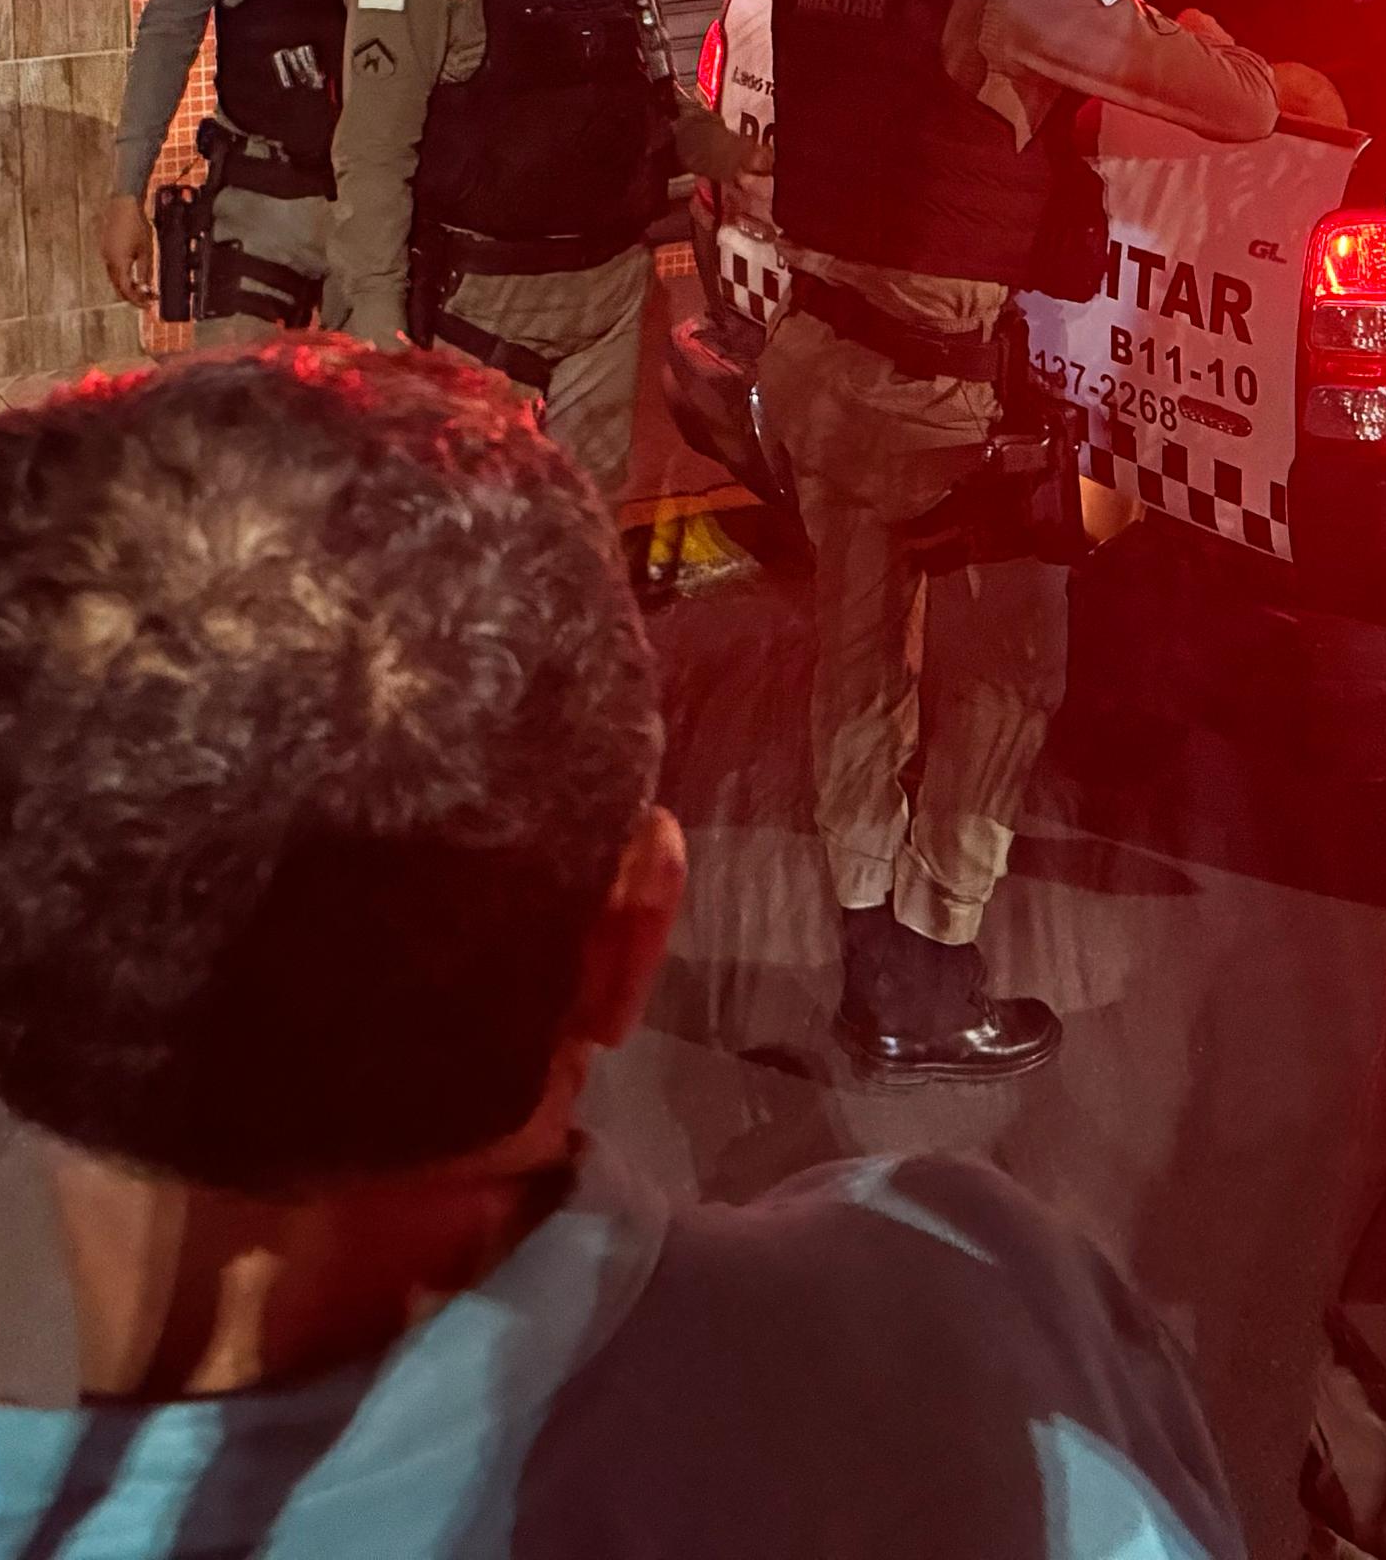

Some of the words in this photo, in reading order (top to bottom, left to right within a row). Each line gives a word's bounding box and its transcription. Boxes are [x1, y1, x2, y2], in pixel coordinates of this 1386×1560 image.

[1107, 239, 1253, 345] ITAR
[1248, 239, 1288, 264] GL
[1110, 324, 1259, 406] B11-10
